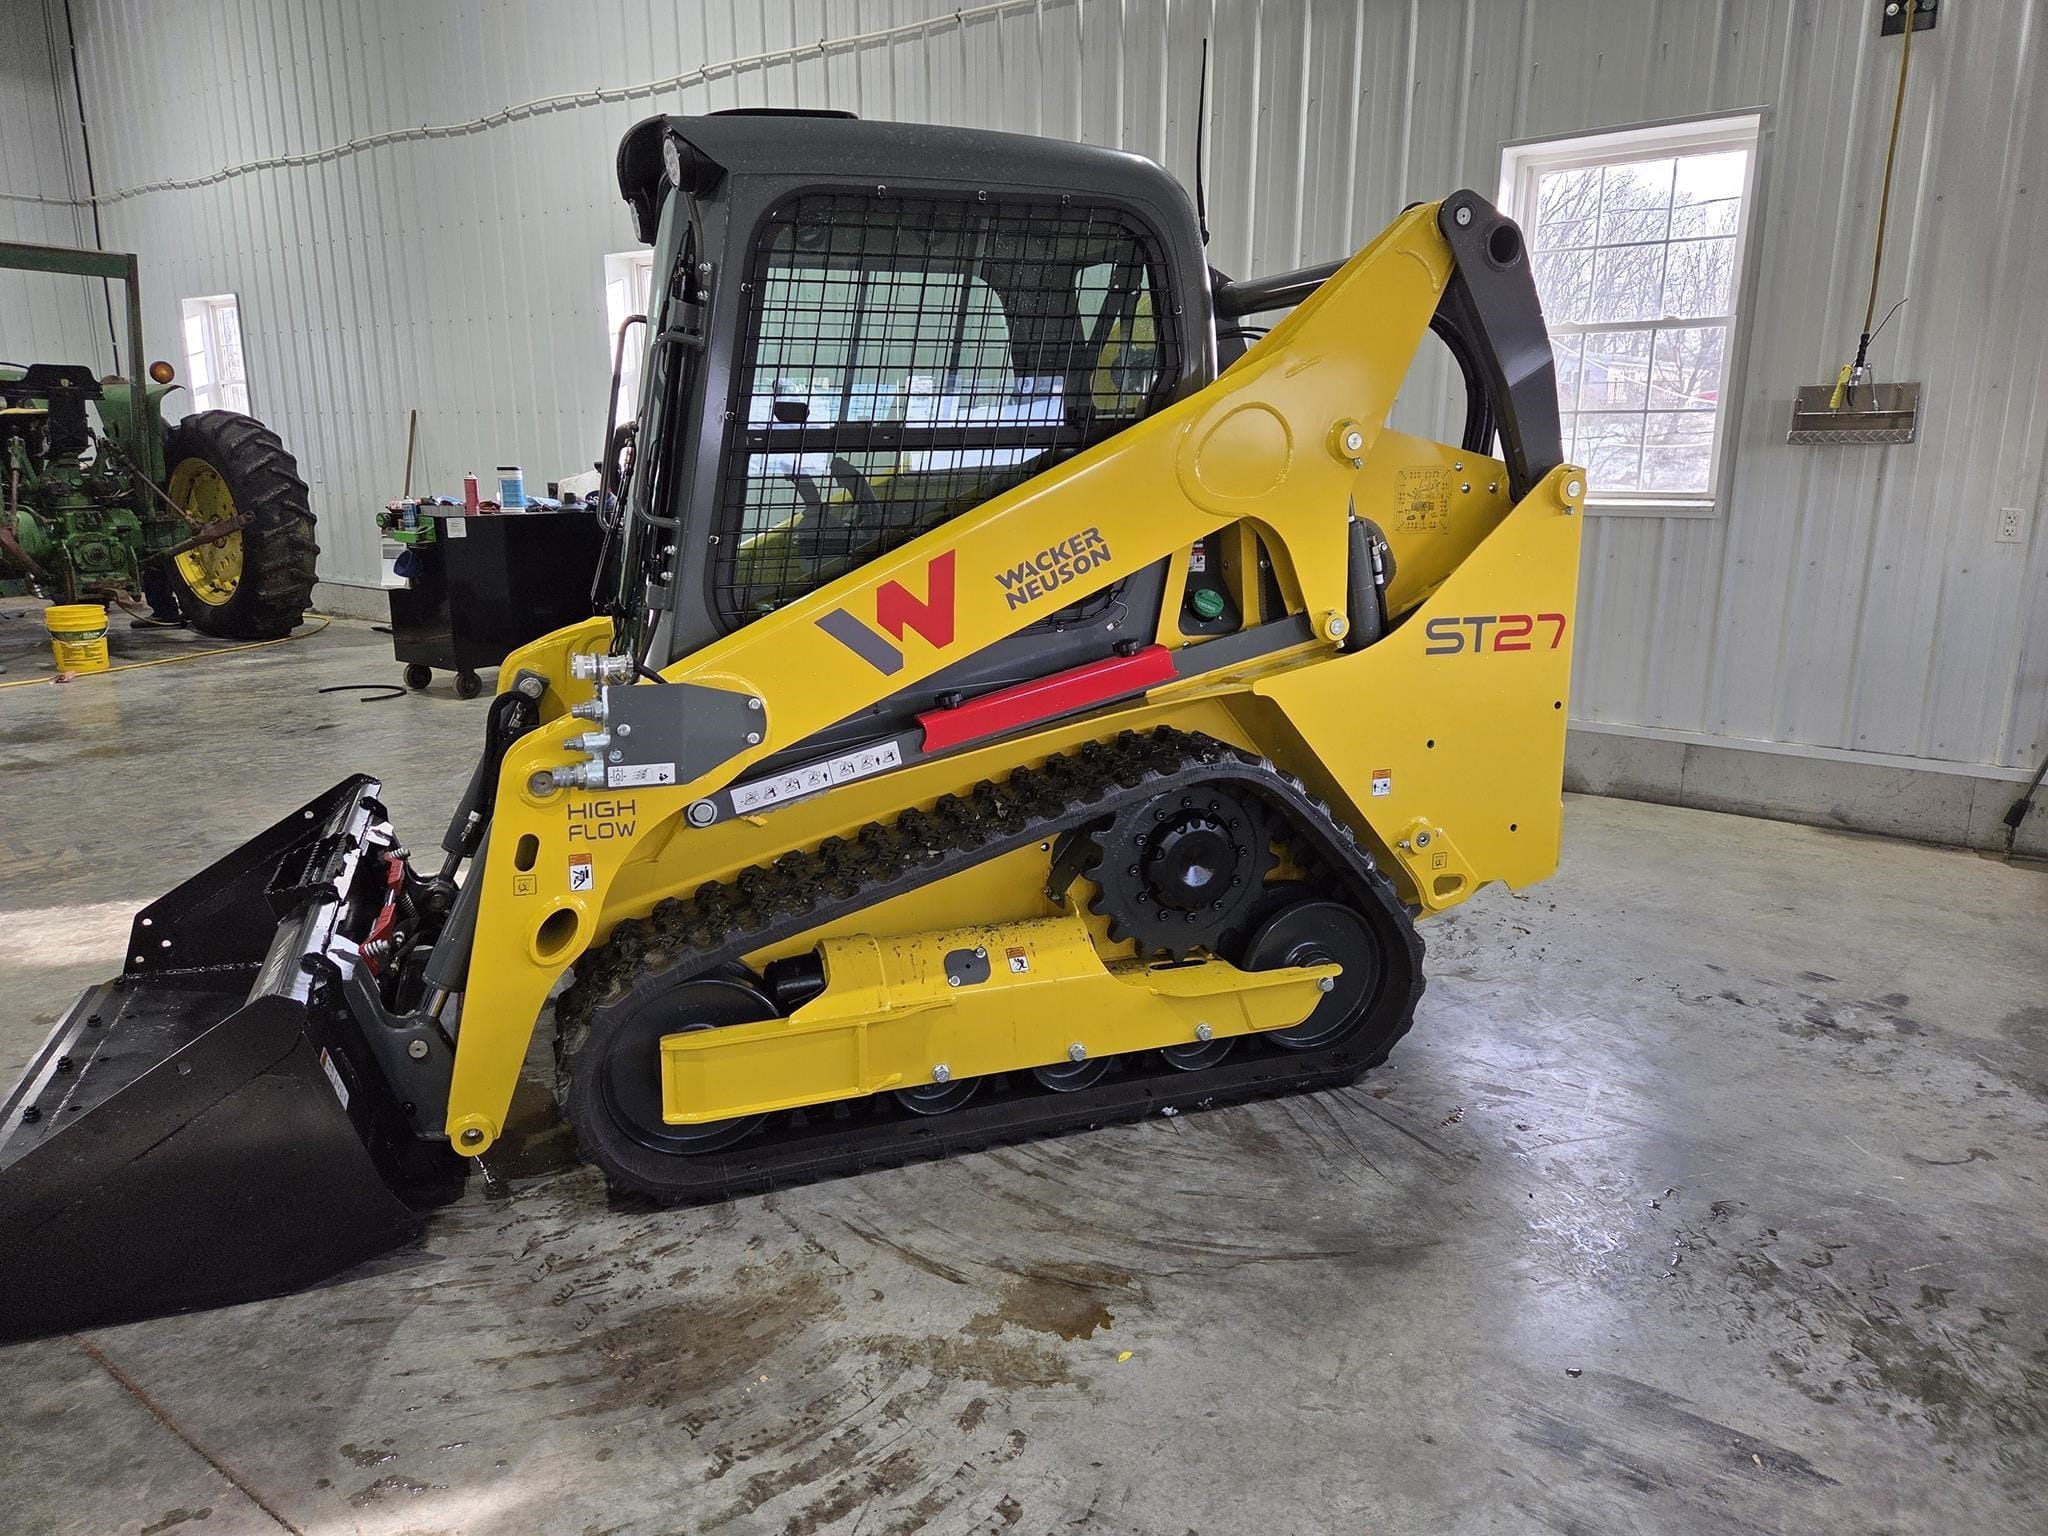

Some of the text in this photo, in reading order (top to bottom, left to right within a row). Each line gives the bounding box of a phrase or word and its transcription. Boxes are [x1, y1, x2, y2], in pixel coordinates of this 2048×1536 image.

[994, 527, 1104, 590] WACKER
[1005, 544, 1111, 610] NEUSON
[1426, 613, 1566, 655] ST27
[568, 799, 636, 820] HIGH
[569, 820, 636, 842] FLOW
